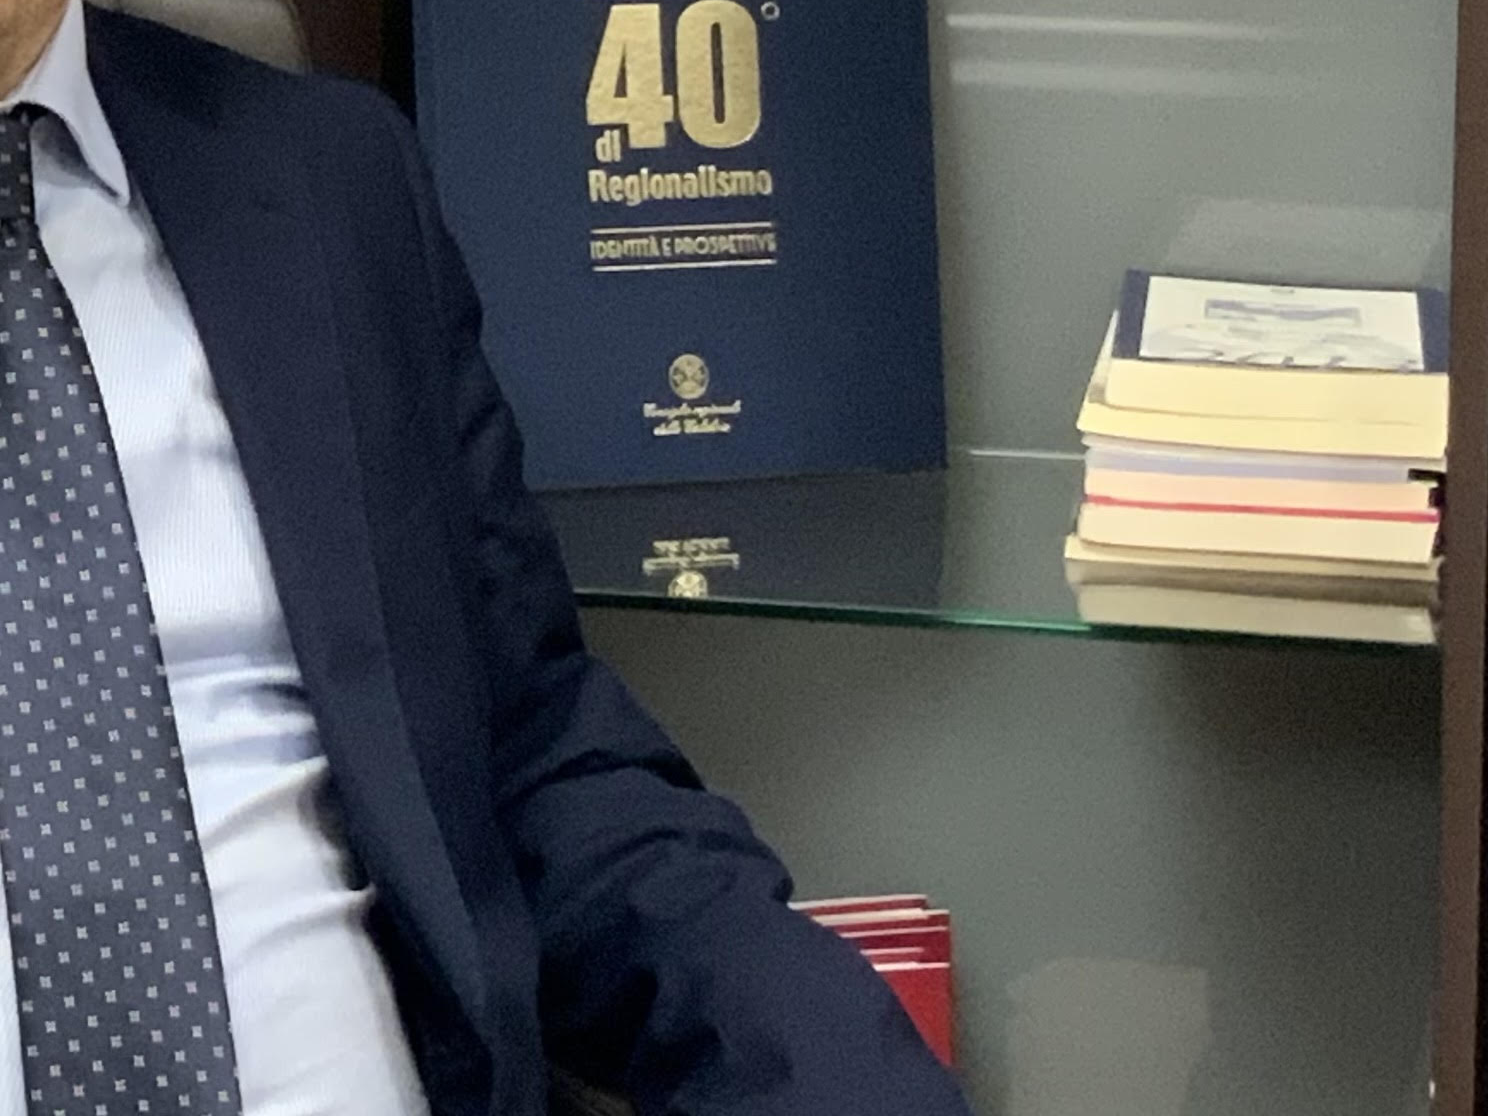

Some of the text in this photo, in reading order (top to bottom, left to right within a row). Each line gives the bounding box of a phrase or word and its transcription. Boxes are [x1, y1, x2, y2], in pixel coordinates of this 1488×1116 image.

[595, 130, 622, 163] di
[588, 165, 773, 206] Regionalismo
[662, 237, 672, 257] E
